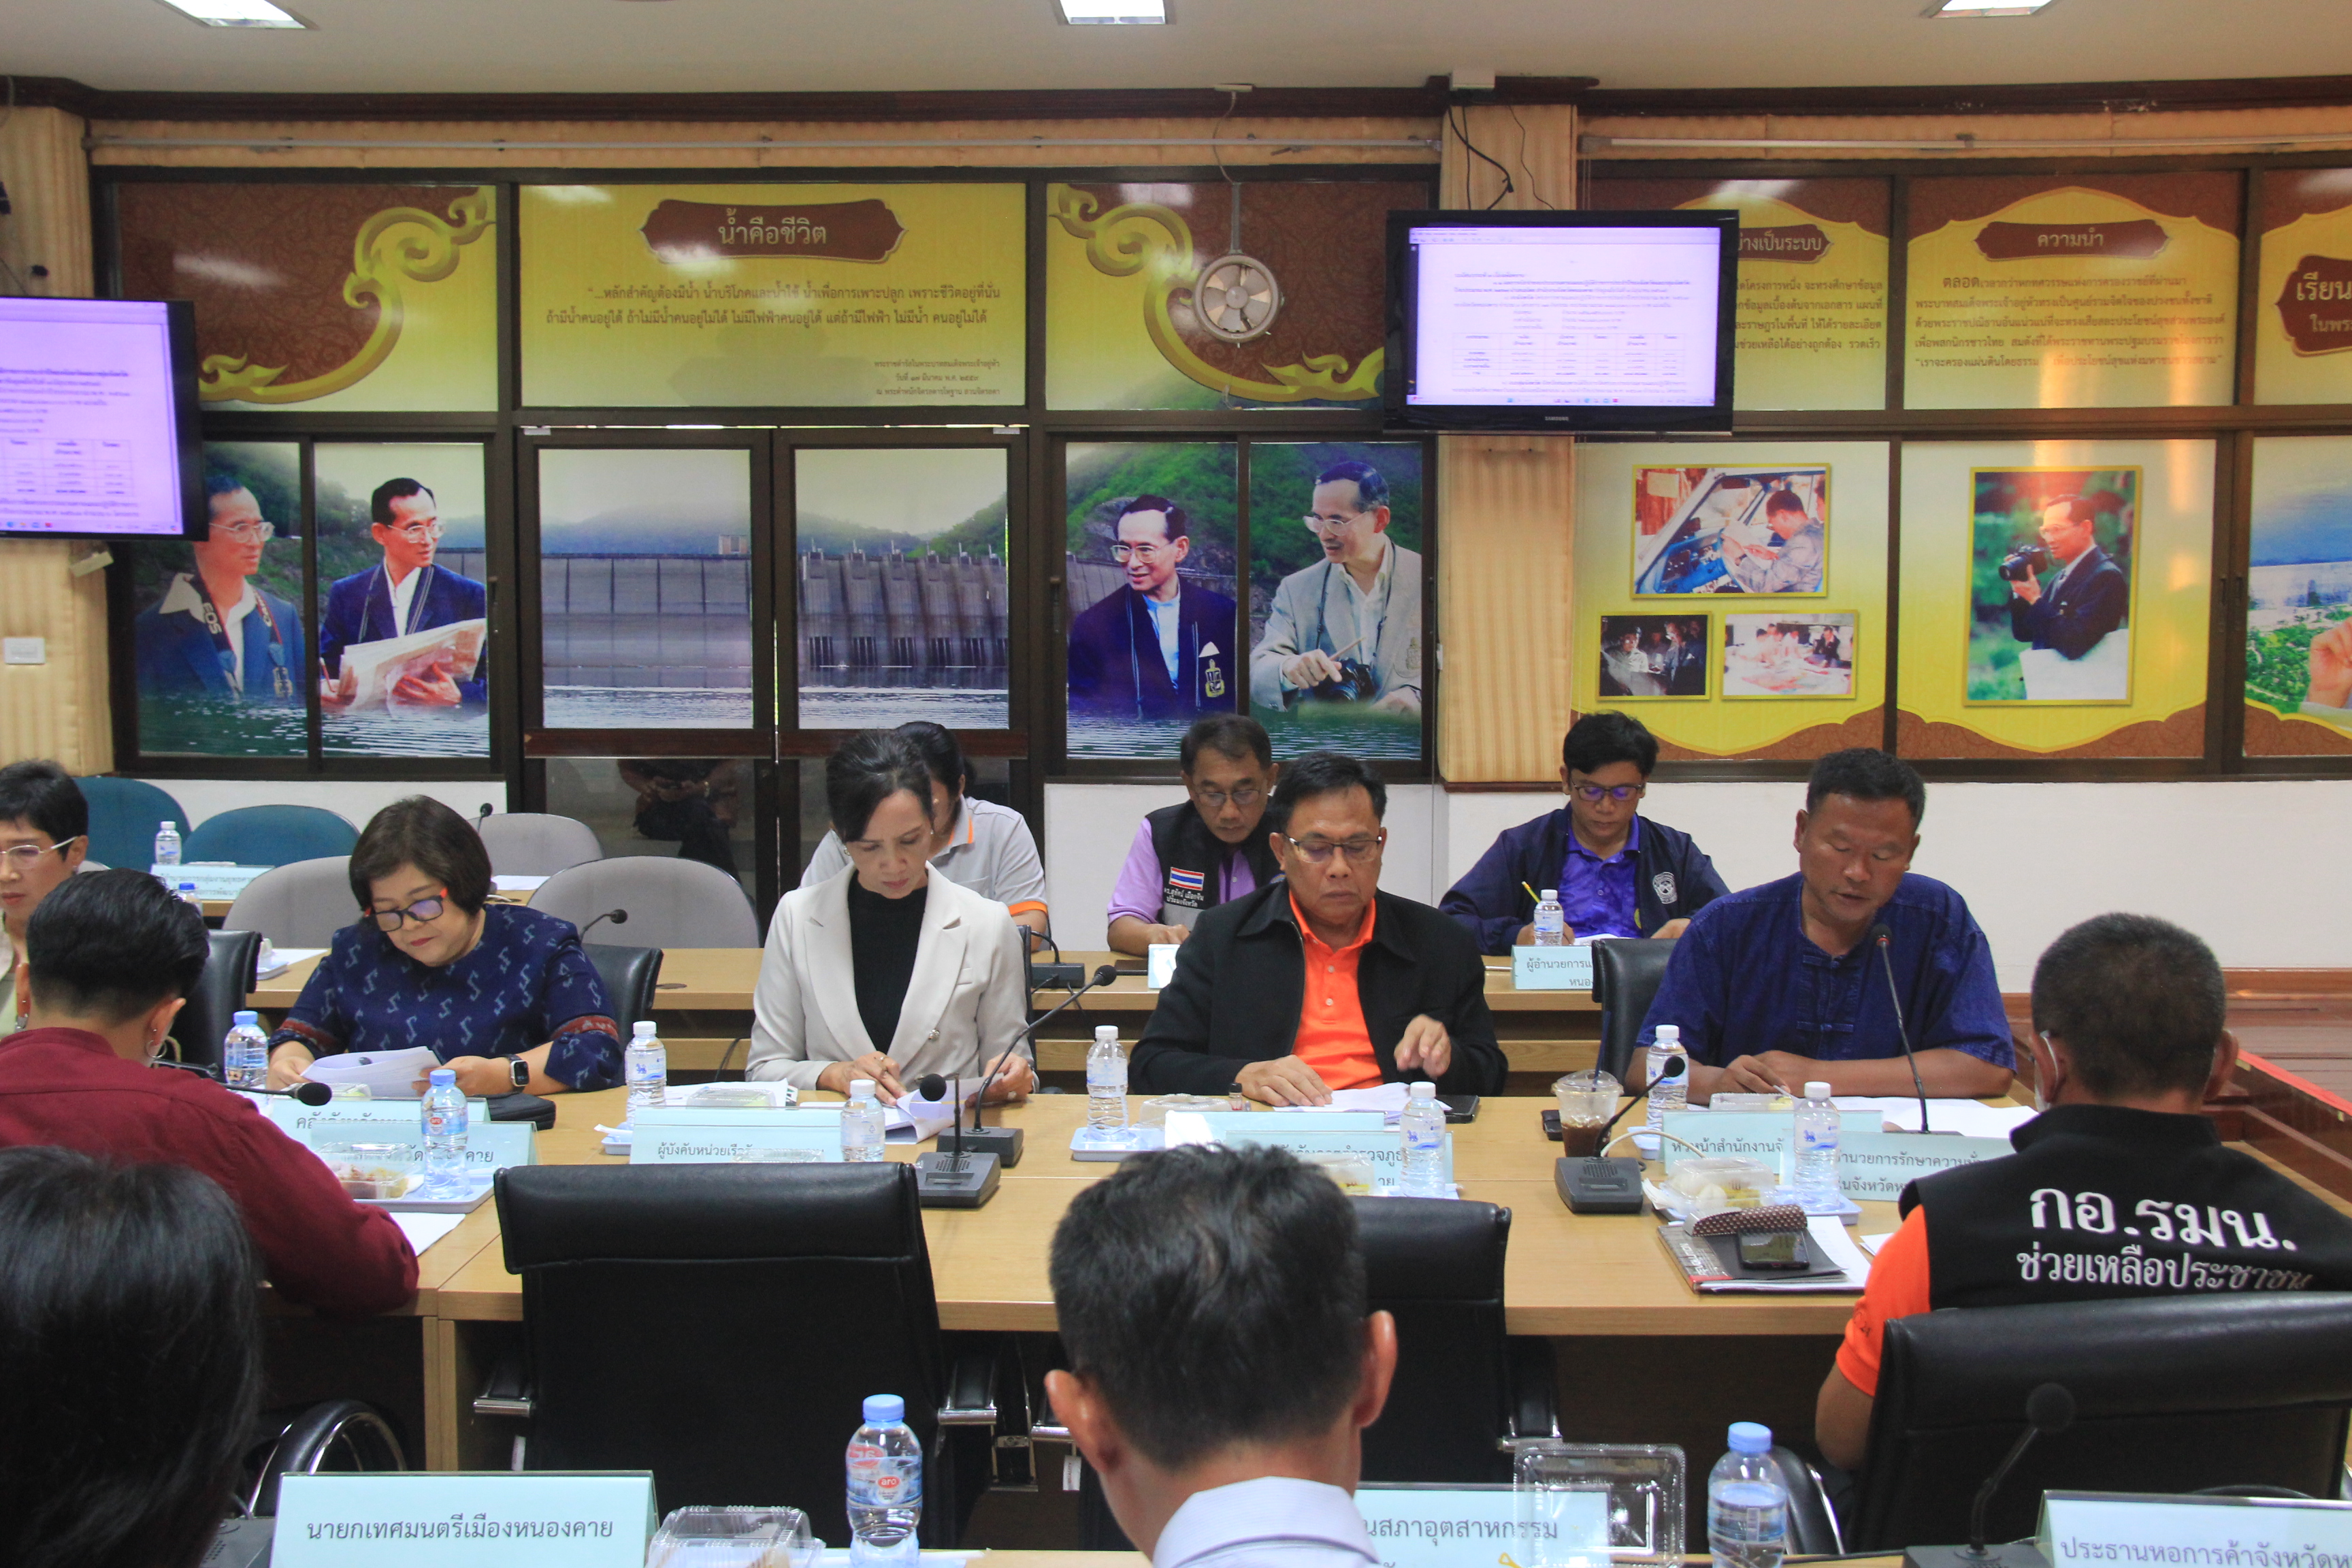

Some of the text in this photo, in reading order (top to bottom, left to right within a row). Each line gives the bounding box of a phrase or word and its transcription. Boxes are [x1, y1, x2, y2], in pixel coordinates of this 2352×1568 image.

[718, 208, 827, 244] น้ำคือชีวิต
[2038, 227, 2104, 247] ความนำ
[803, 280, 904, 304] น้ำเพื่อการเพาะปลูก
[909, 282, 1000, 304] เพราะชีวิตอยู่ที่นั่น
[1737, 278, 1882, 293] ดโครงการหนึ่ง จะทรงศึกษาข้อมูล
[2296, 271, 2352, 301] เรียน
[1737, 295, 1852, 313] กข้อมูลเบื้องต้นจากเอกสาร
[546, 306, 987, 329] ถ้ามีน้ำคนอยู่ได้ ถ้าไม่มีน้ำคนอยู่ไม่ได้ ไม่มีไฟฟ้าคนอยู่ได้ แต่ถ้ามีไฟฟ้า ไม่มีน้ำ คนอยู่ไม่ได้
[1811, 318, 1882, 329] ให้ได้รายละเอียด
[1848, 338, 1880, 349] รวดเร็ว
[1569, 978, 1593, 987] หนอ
[2029, 1188, 2299, 1252] กอ.รมน.
[2016, 1241, 2313, 1290] ช่วยเหลือประชาชน
[881, 1478, 898, 1486] aro
[307, 1512, 613, 1539] นายกเทศมนตรีเมืองหนองคาย
[2060, 1537, 2352, 1568] ประธานหอการค้าจังหวัดห
